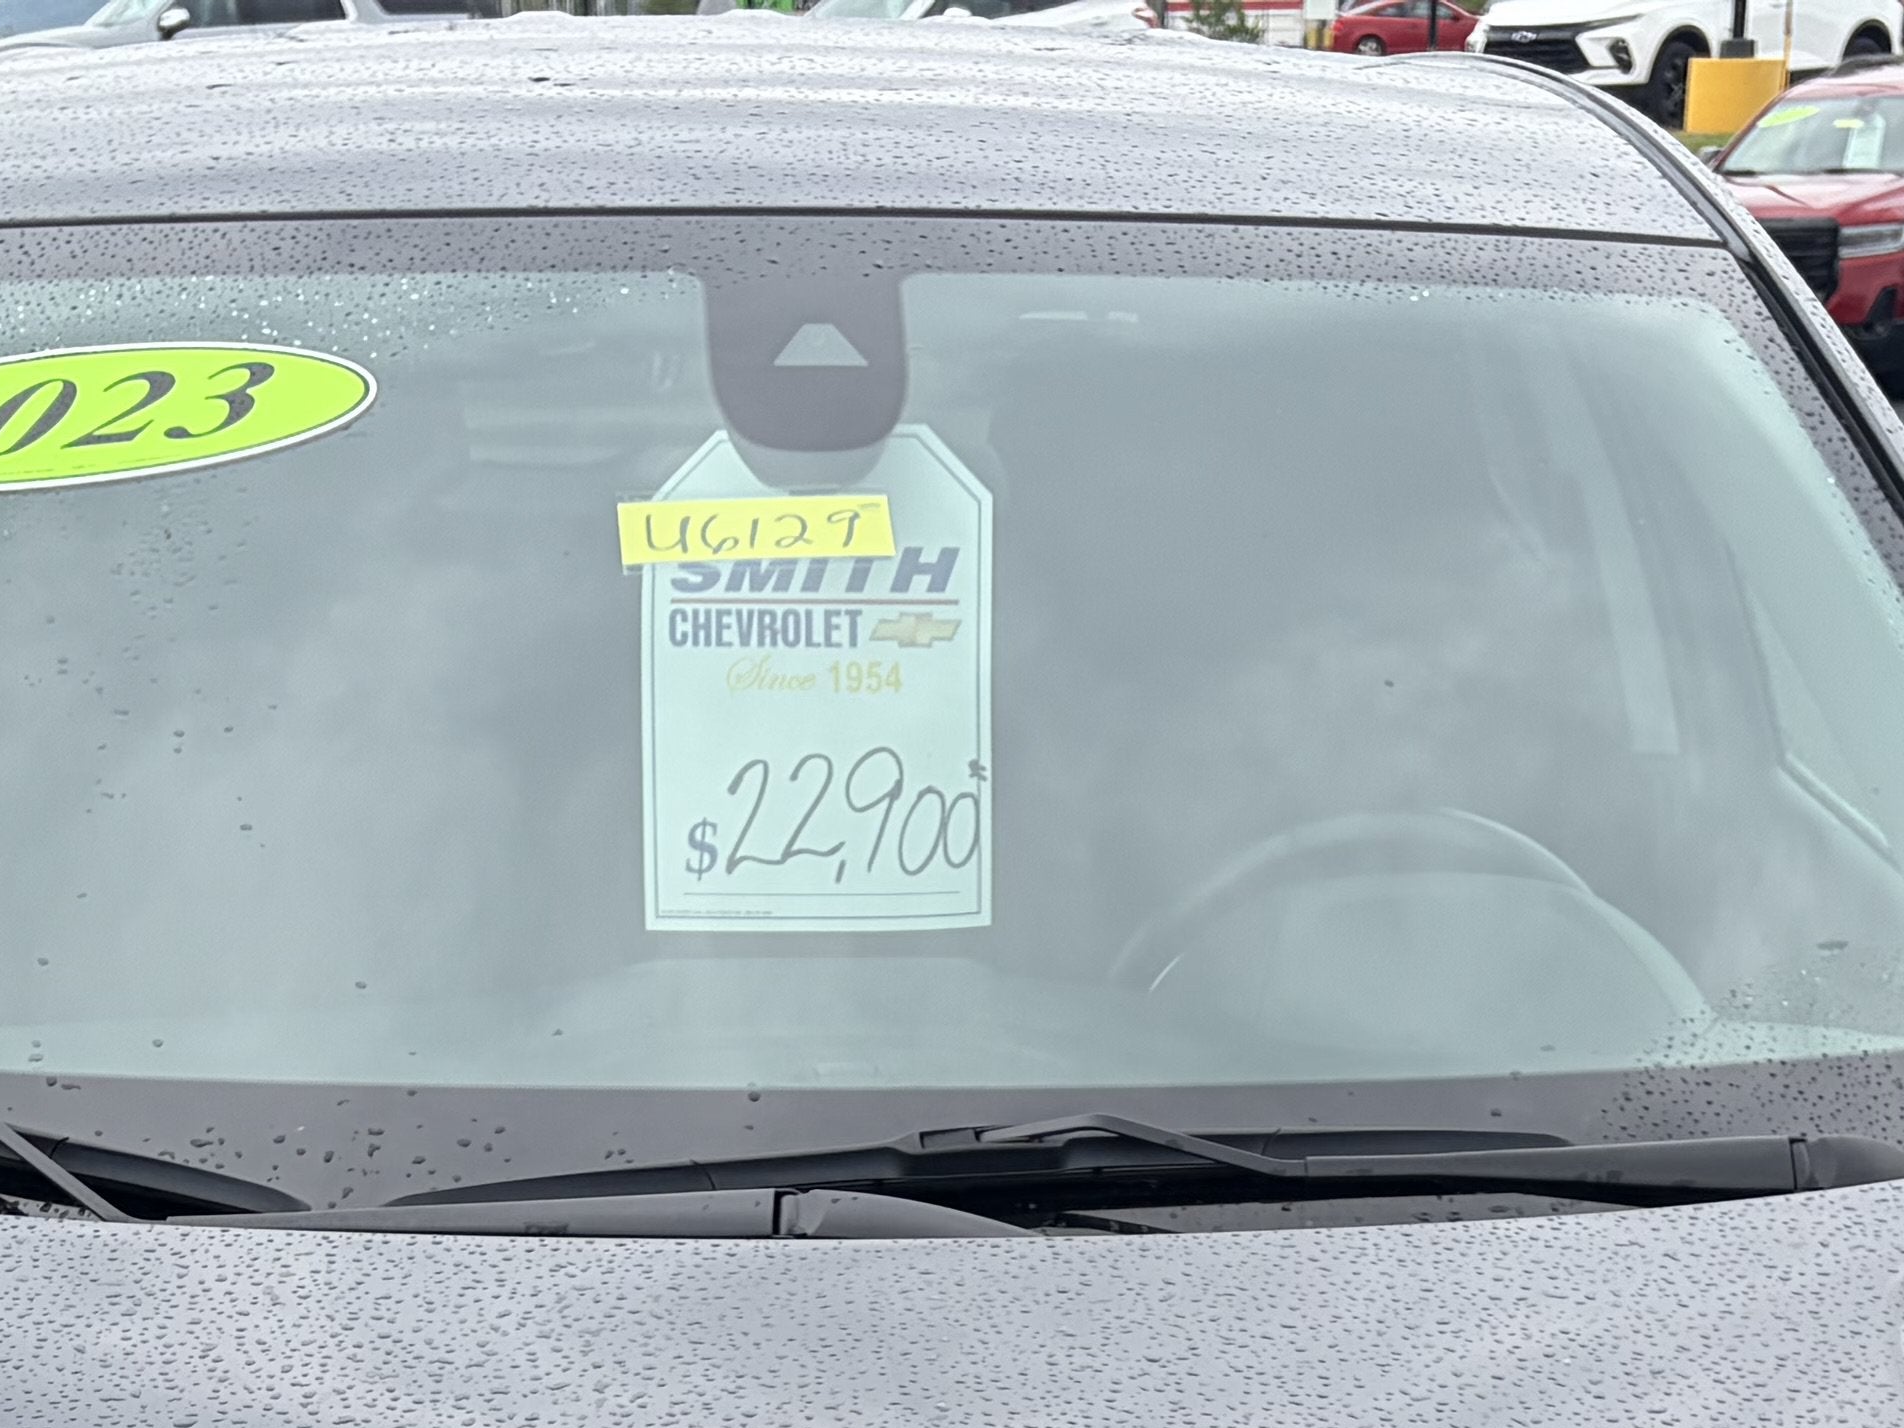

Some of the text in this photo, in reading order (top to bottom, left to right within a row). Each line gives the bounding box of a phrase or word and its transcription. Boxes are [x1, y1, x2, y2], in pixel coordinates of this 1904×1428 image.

[669, 547, 960, 594] SMITH
[667, 607, 864, 649] CHEVROLET
[726, 653, 904, 694] Since 1954
